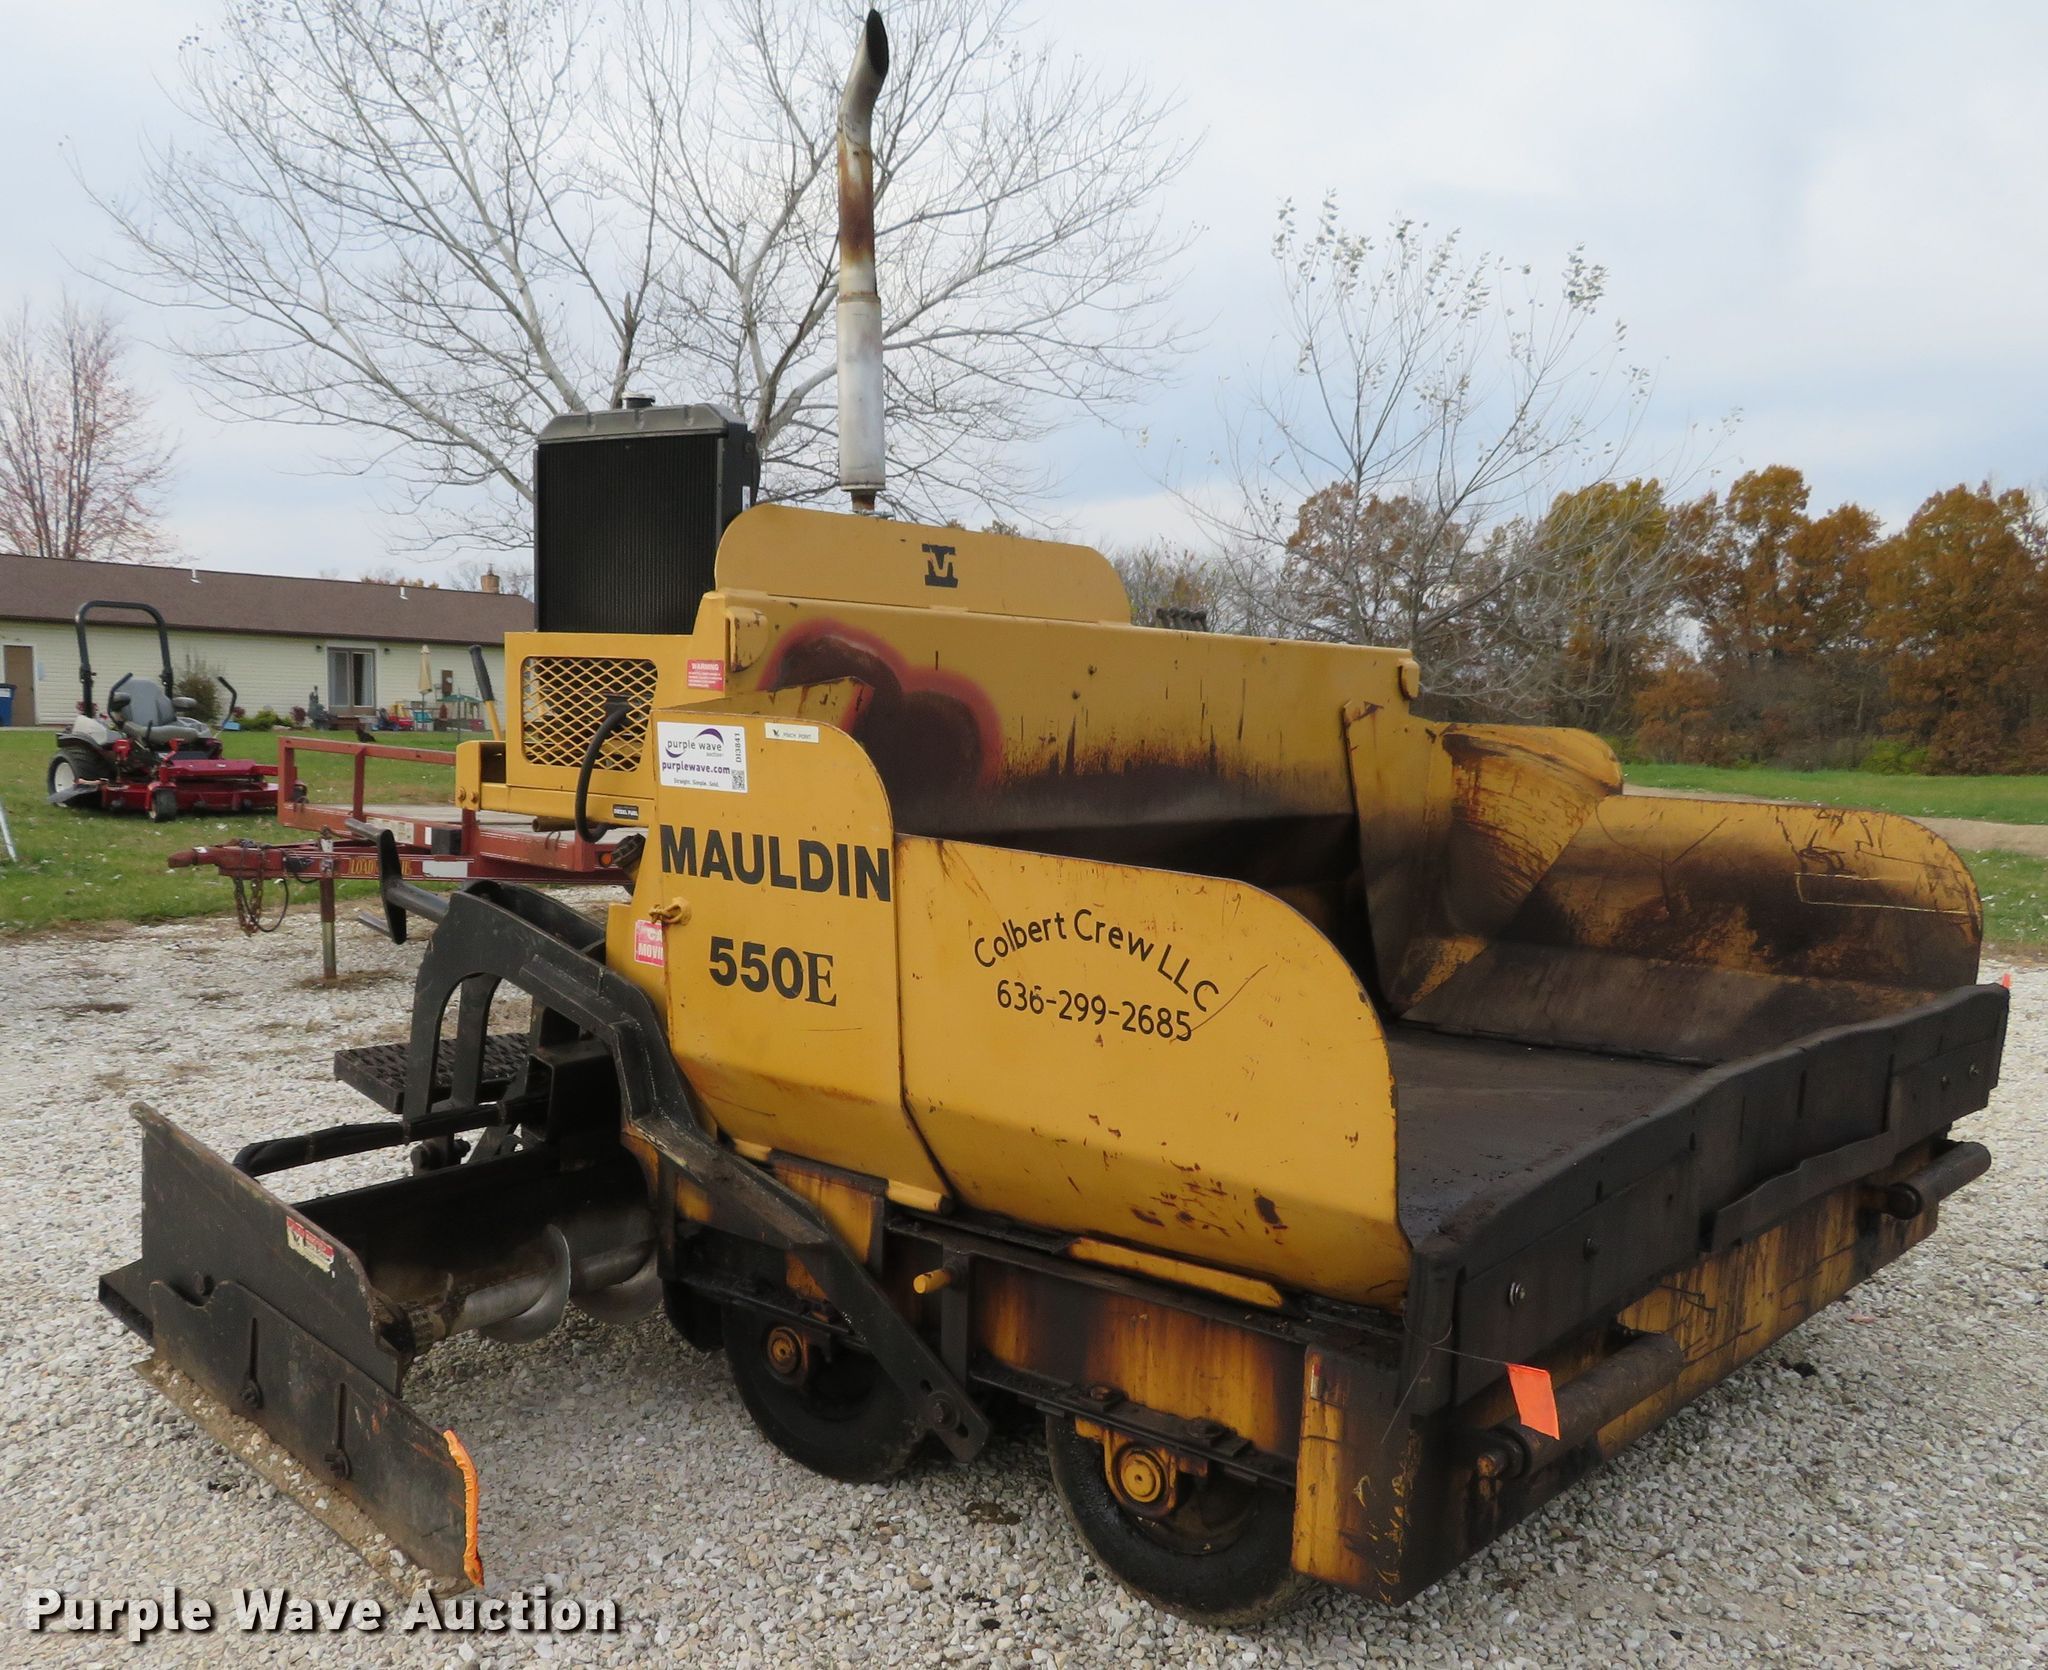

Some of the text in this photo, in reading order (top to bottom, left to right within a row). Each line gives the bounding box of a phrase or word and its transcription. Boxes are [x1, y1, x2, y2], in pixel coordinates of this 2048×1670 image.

[662, 761, 731, 775] purplewave.com
[667, 740, 722, 751] purple wave
[660, 824, 891, 902] MAULDIN
[709, 936, 837, 1007] 550E
[974, 909, 1219, 1013] Colbert Crew LLC
[997, 979, 1192, 1042] 636-299-2685
